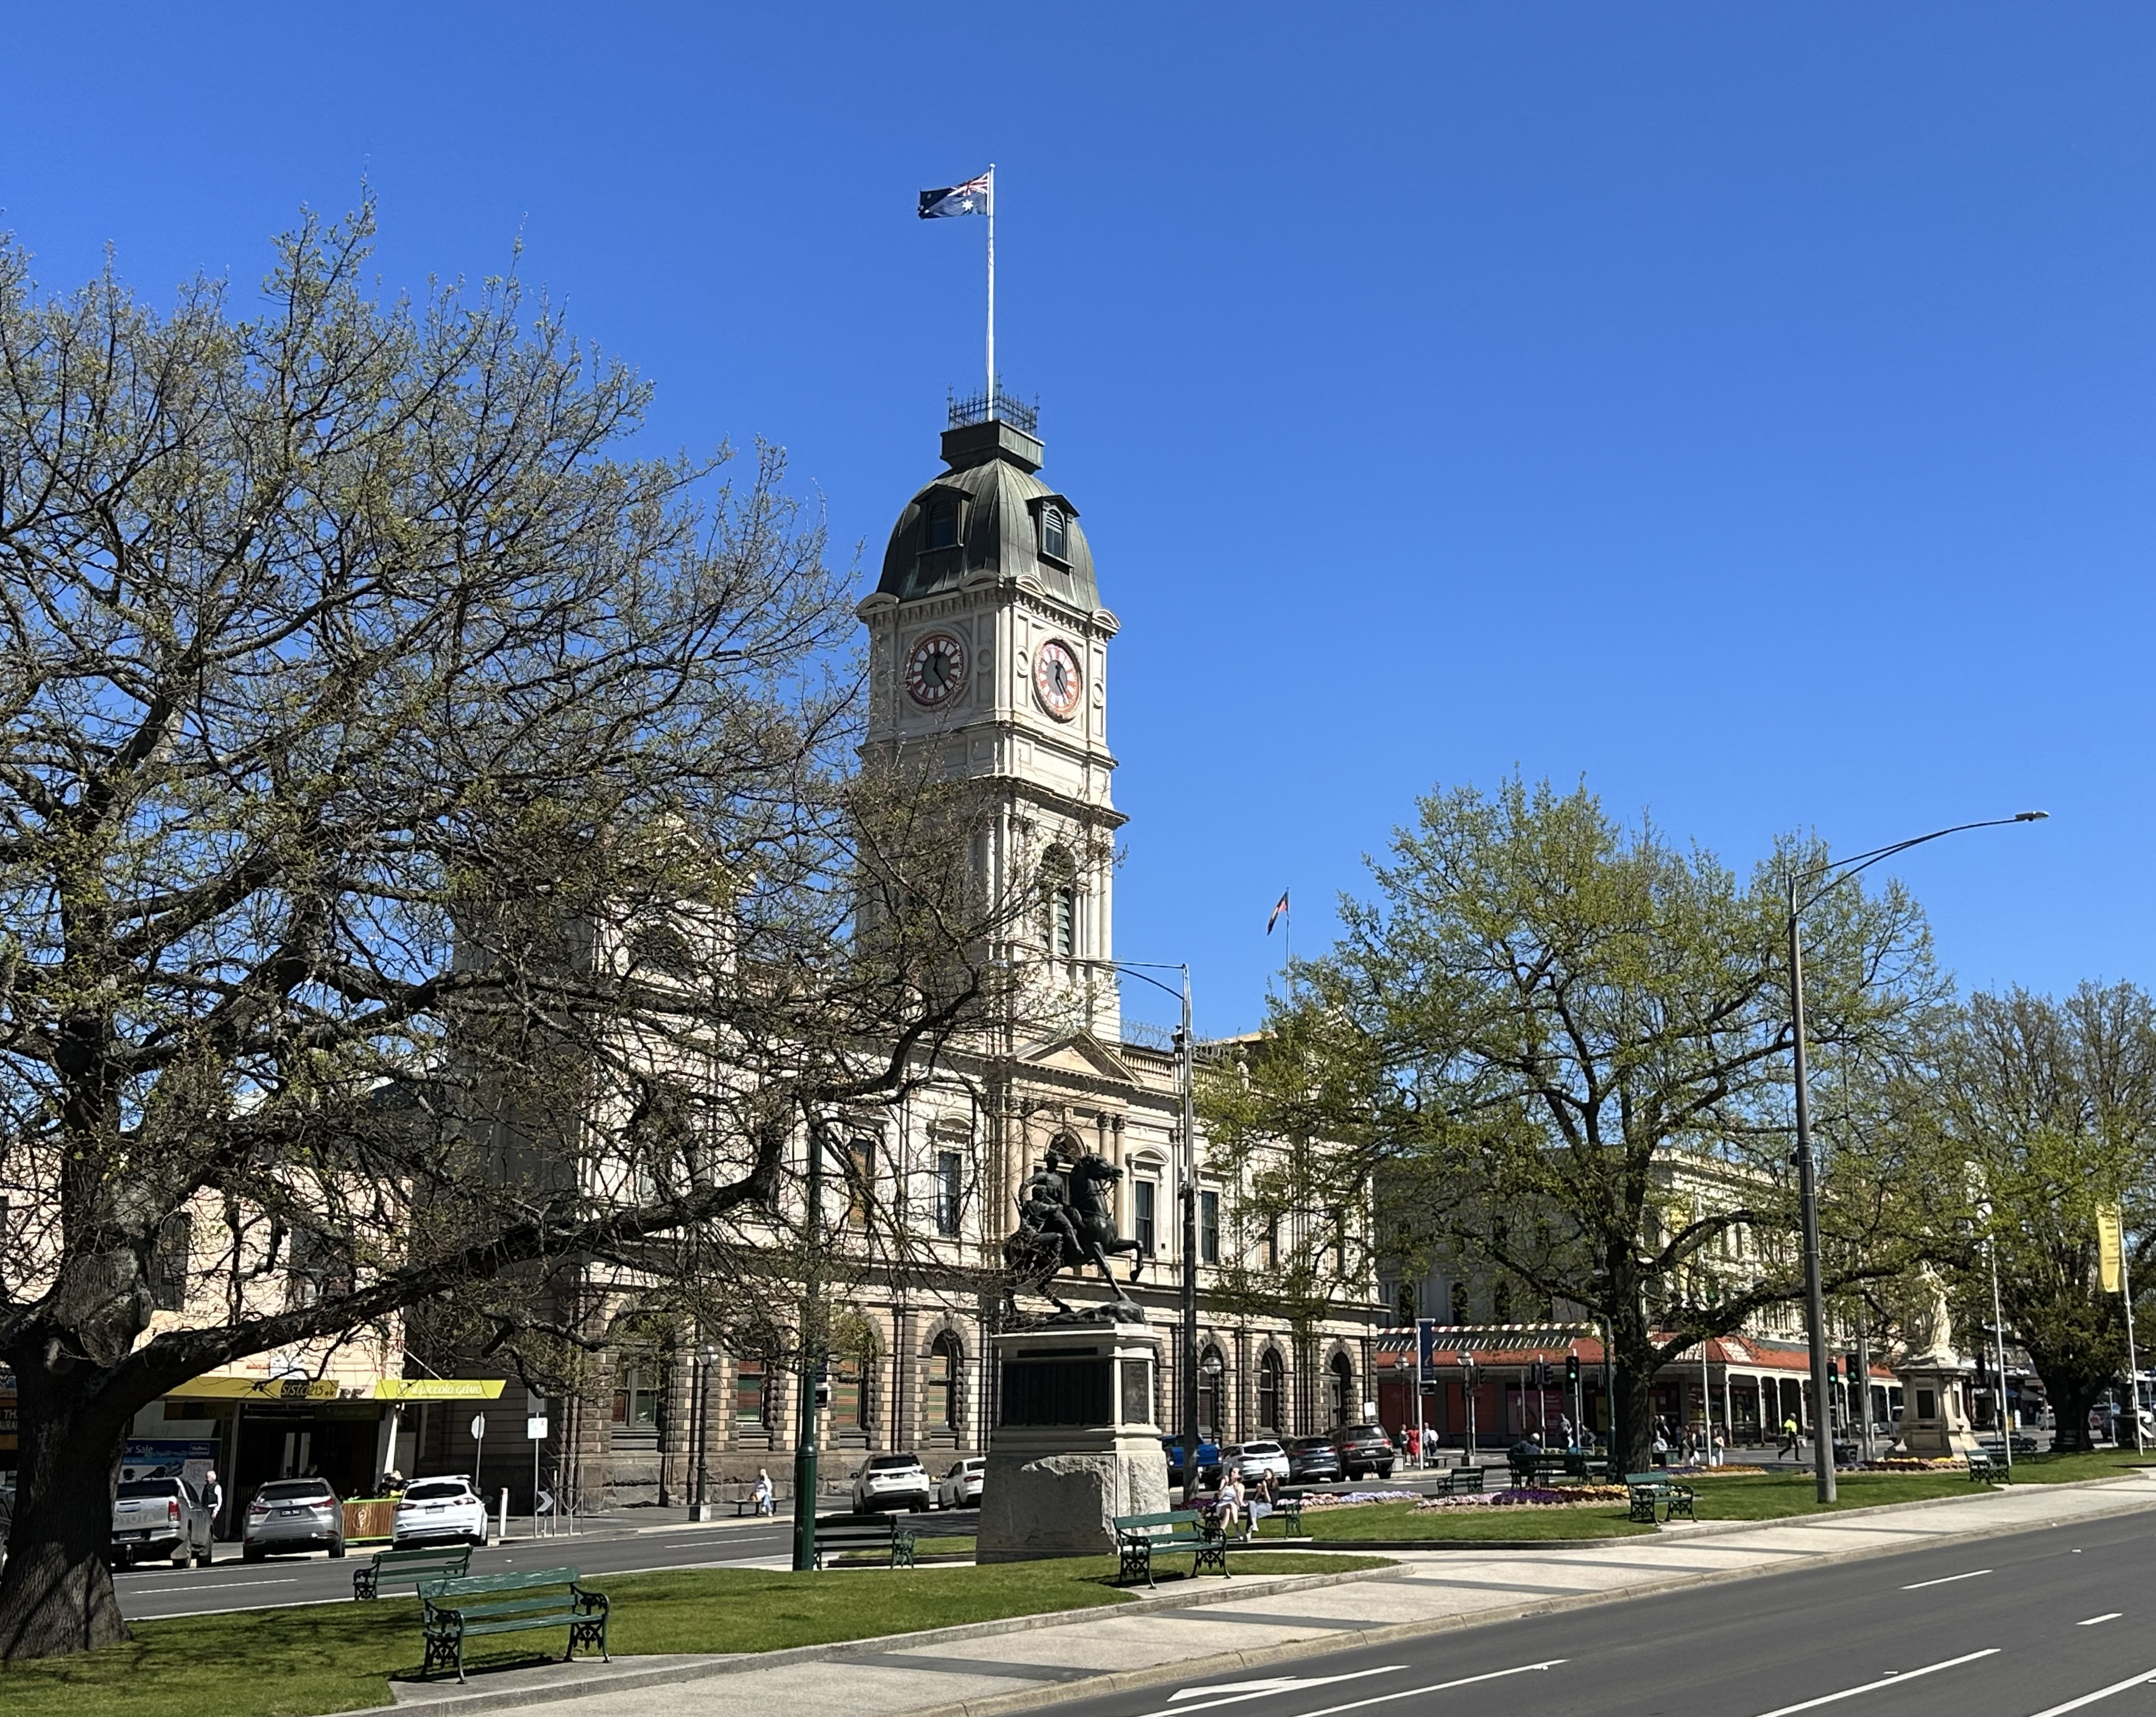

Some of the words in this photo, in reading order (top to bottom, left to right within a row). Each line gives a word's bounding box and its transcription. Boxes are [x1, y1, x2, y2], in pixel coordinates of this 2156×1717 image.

[3, 1409, 18, 1420] TH
[135, 1445, 153, 1454] Sale
[114, 1514, 155, 1525] OYOTA
